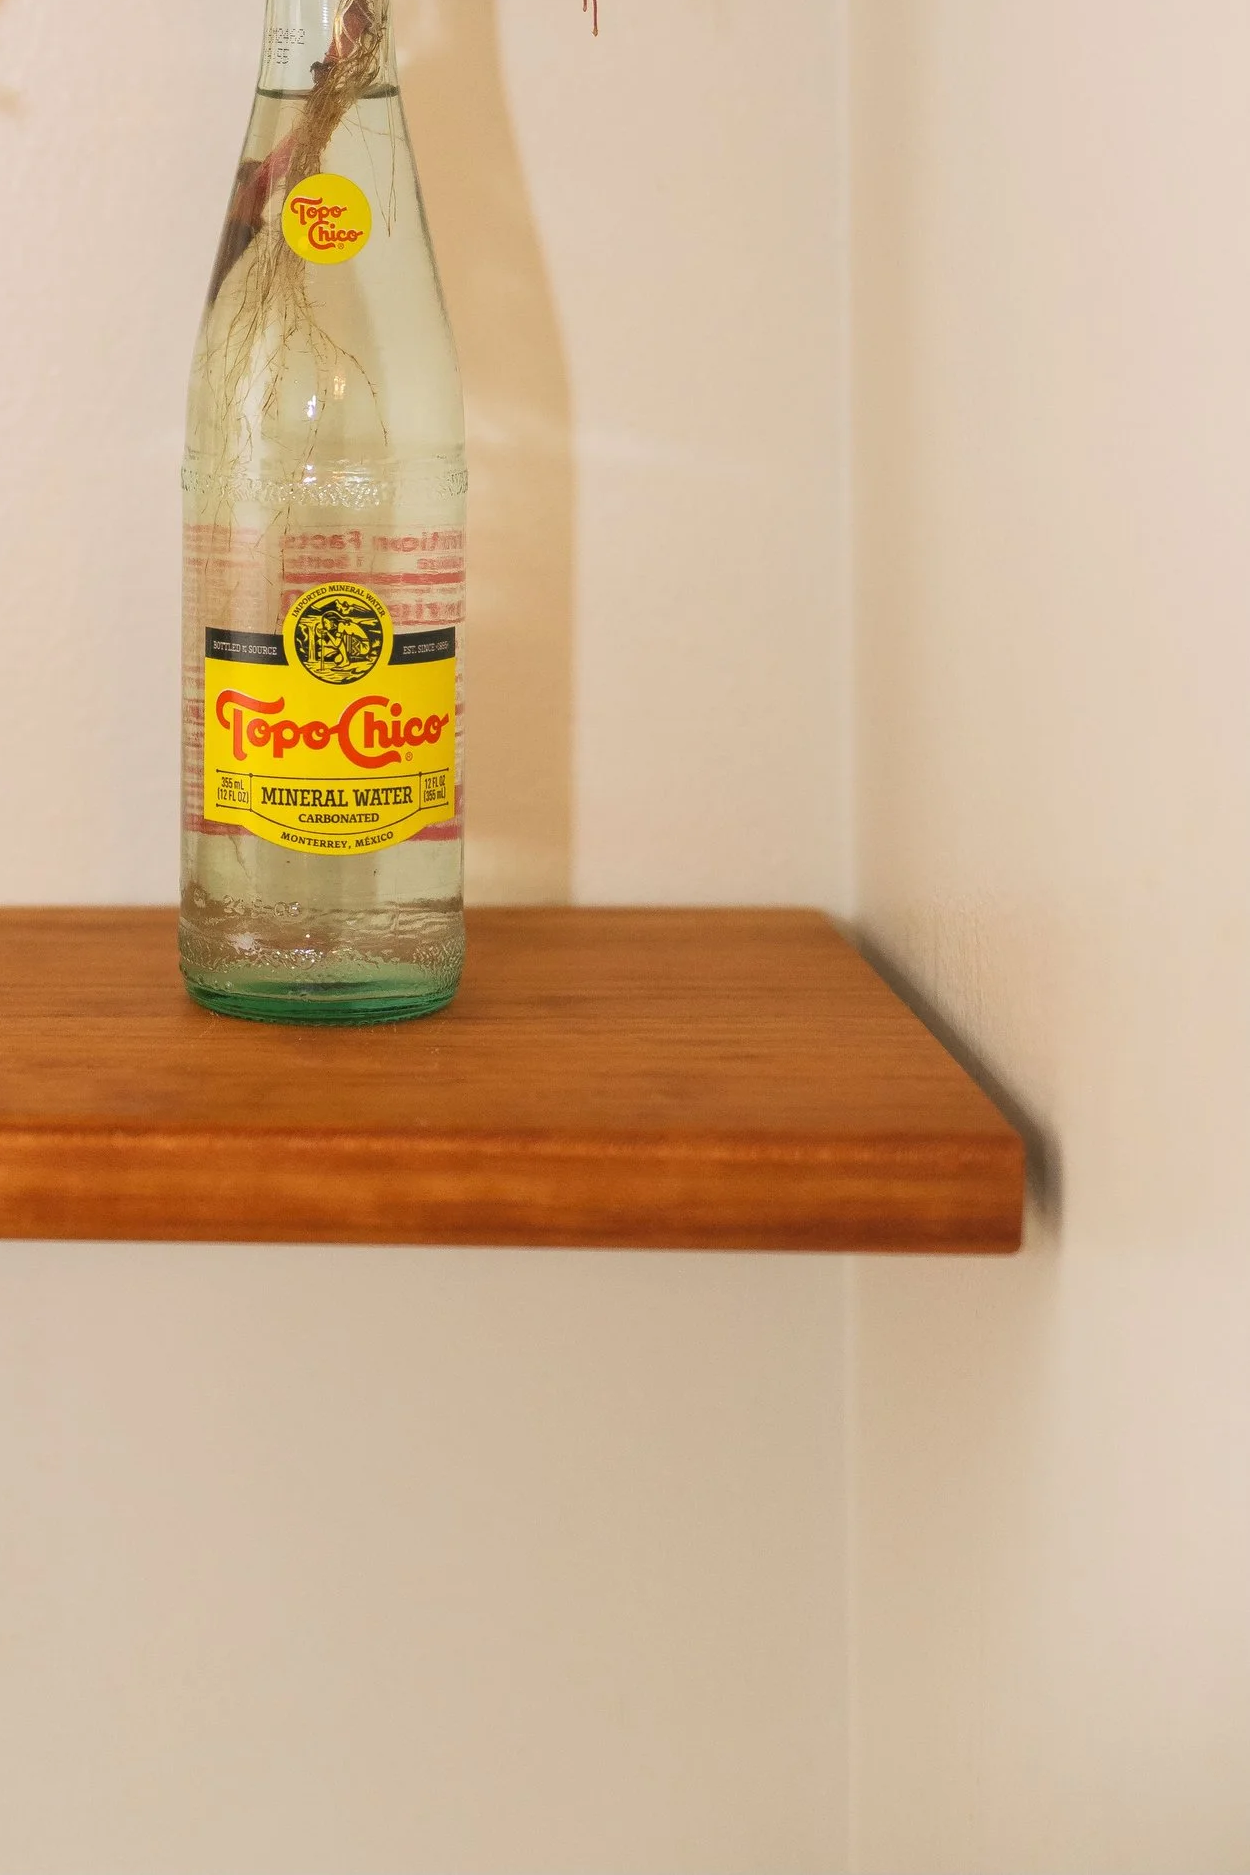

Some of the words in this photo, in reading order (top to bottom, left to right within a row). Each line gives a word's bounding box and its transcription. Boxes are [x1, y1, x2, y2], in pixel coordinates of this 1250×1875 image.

[290, 197, 346, 226] Topo
[308, 221, 364, 250] Chico
[291, 587, 327, 618] IMPORTED
[328, 585, 365, 597] MINERAL
[365, 592, 387, 618] WATER
[213, 640, 241, 653] BOTTLED
[248, 644, 278, 656] SOURCE
[403, 645, 417, 655] EST.
[417, 643, 436, 654] SINCE
[216, 689, 340, 762] Topo
[338, 695, 449, 769] Chico
[221, 777, 233, 789] 355
[424, 777, 432, 789] 12
[432, 776, 439, 788] FL
[217, 788, 228, 801] (12
[228, 789, 237, 801] FL
[261, 786, 349, 808] MINERAL
[354, 786, 414, 807] WATER
[423, 789, 436, 803] (355
[298, 812, 380, 824] CARBONATED
[280, 831, 352, 850] MONTERREY,
[354, 830, 394, 848] MÉXICO
